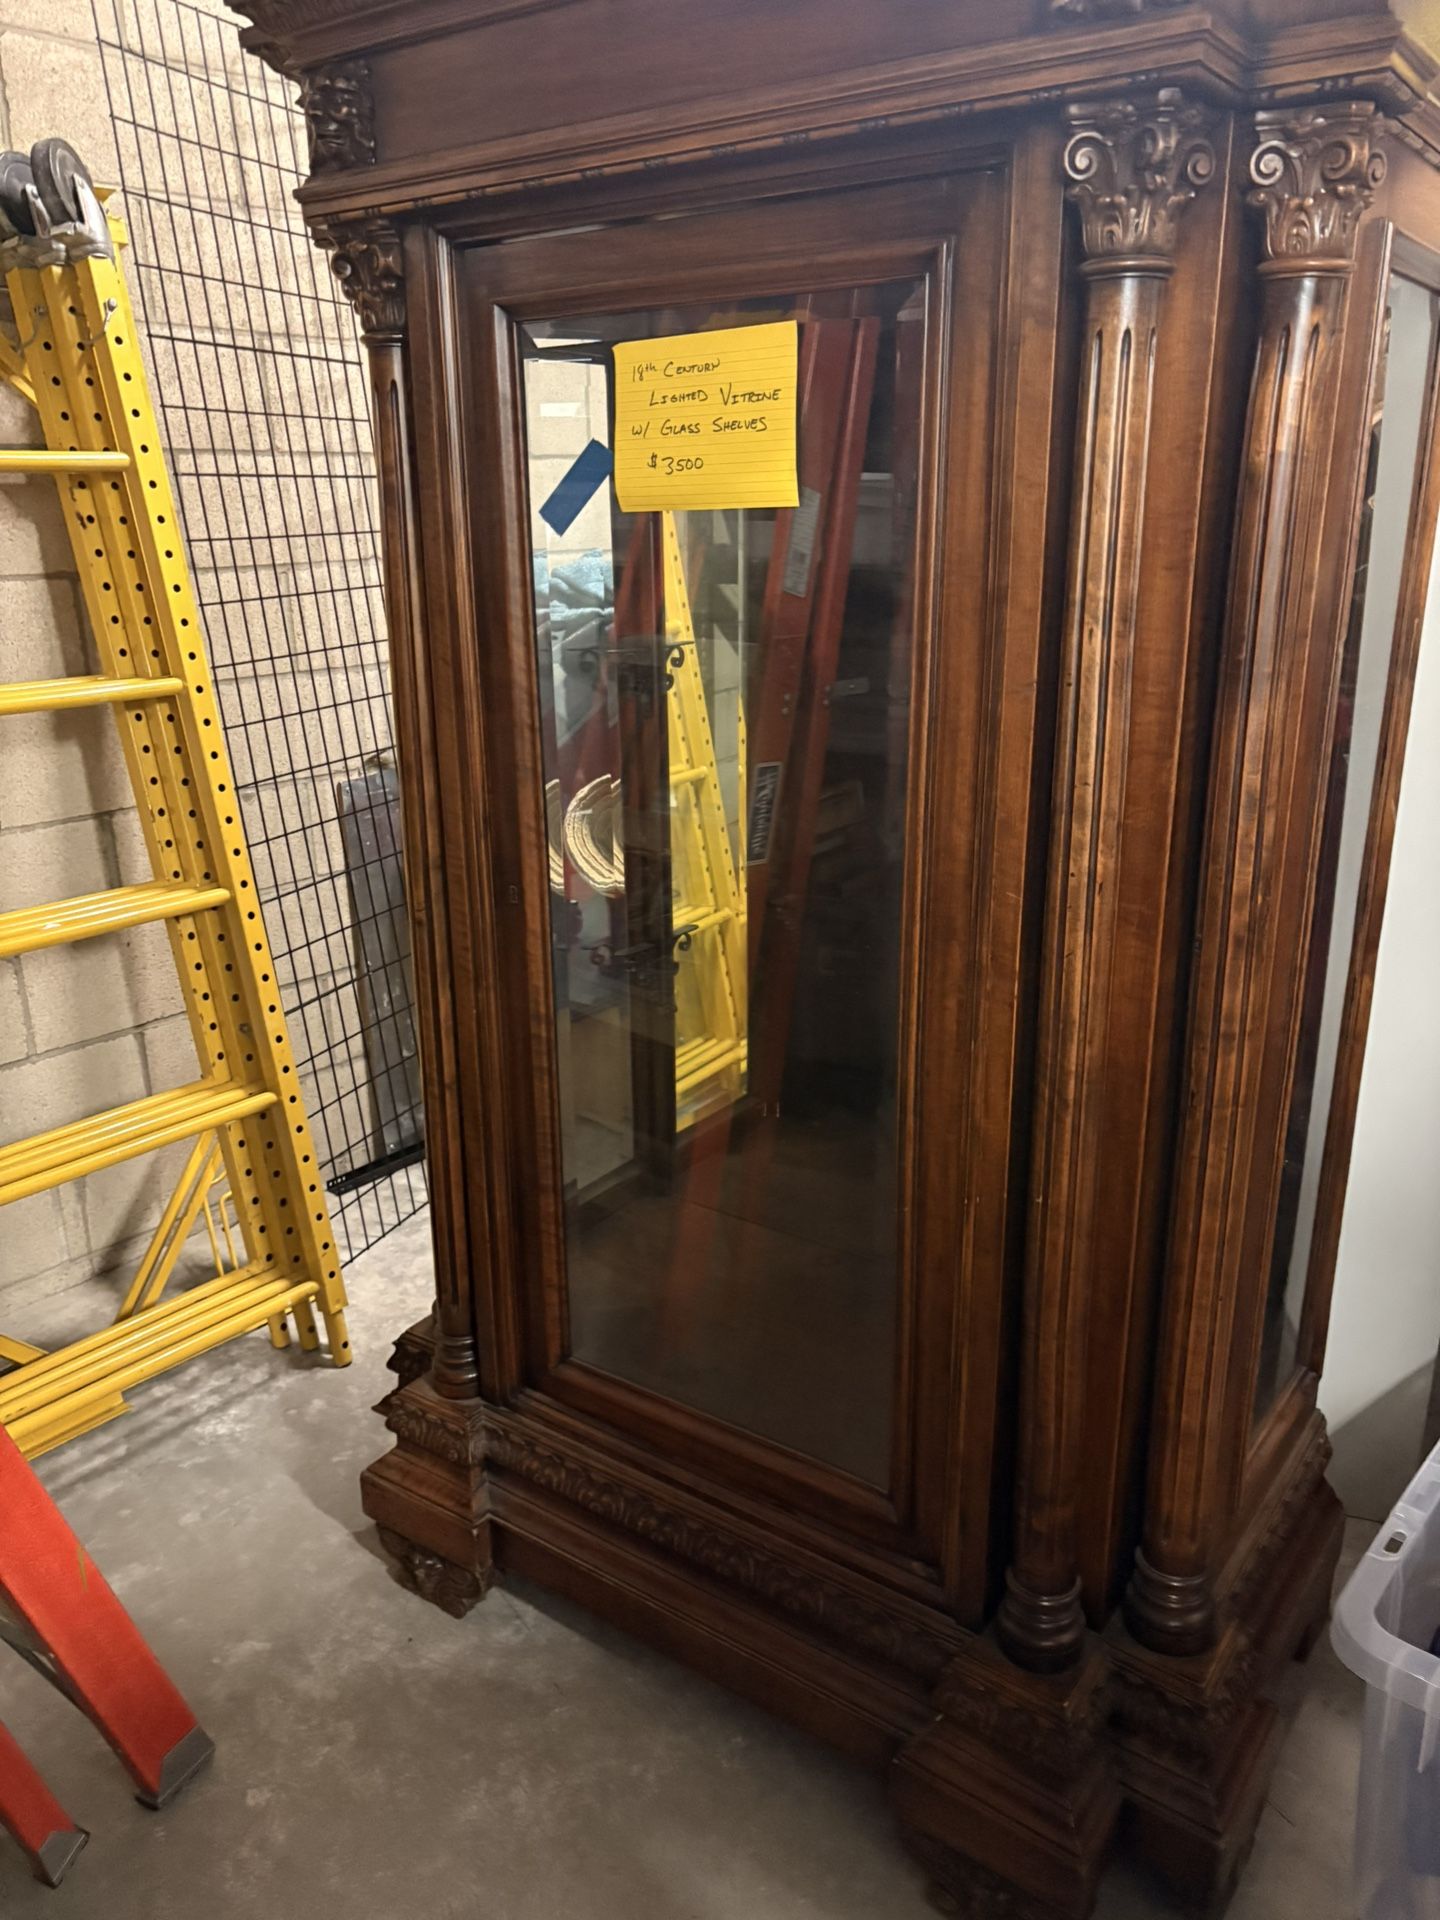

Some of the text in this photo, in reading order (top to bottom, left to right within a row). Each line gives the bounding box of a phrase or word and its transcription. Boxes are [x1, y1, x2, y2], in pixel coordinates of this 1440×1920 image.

[649, 382, 782, 407] LIGHTED VITRINE
[660, 419, 700, 436] GLASS
[713, 416, 768, 433] SHELVES
